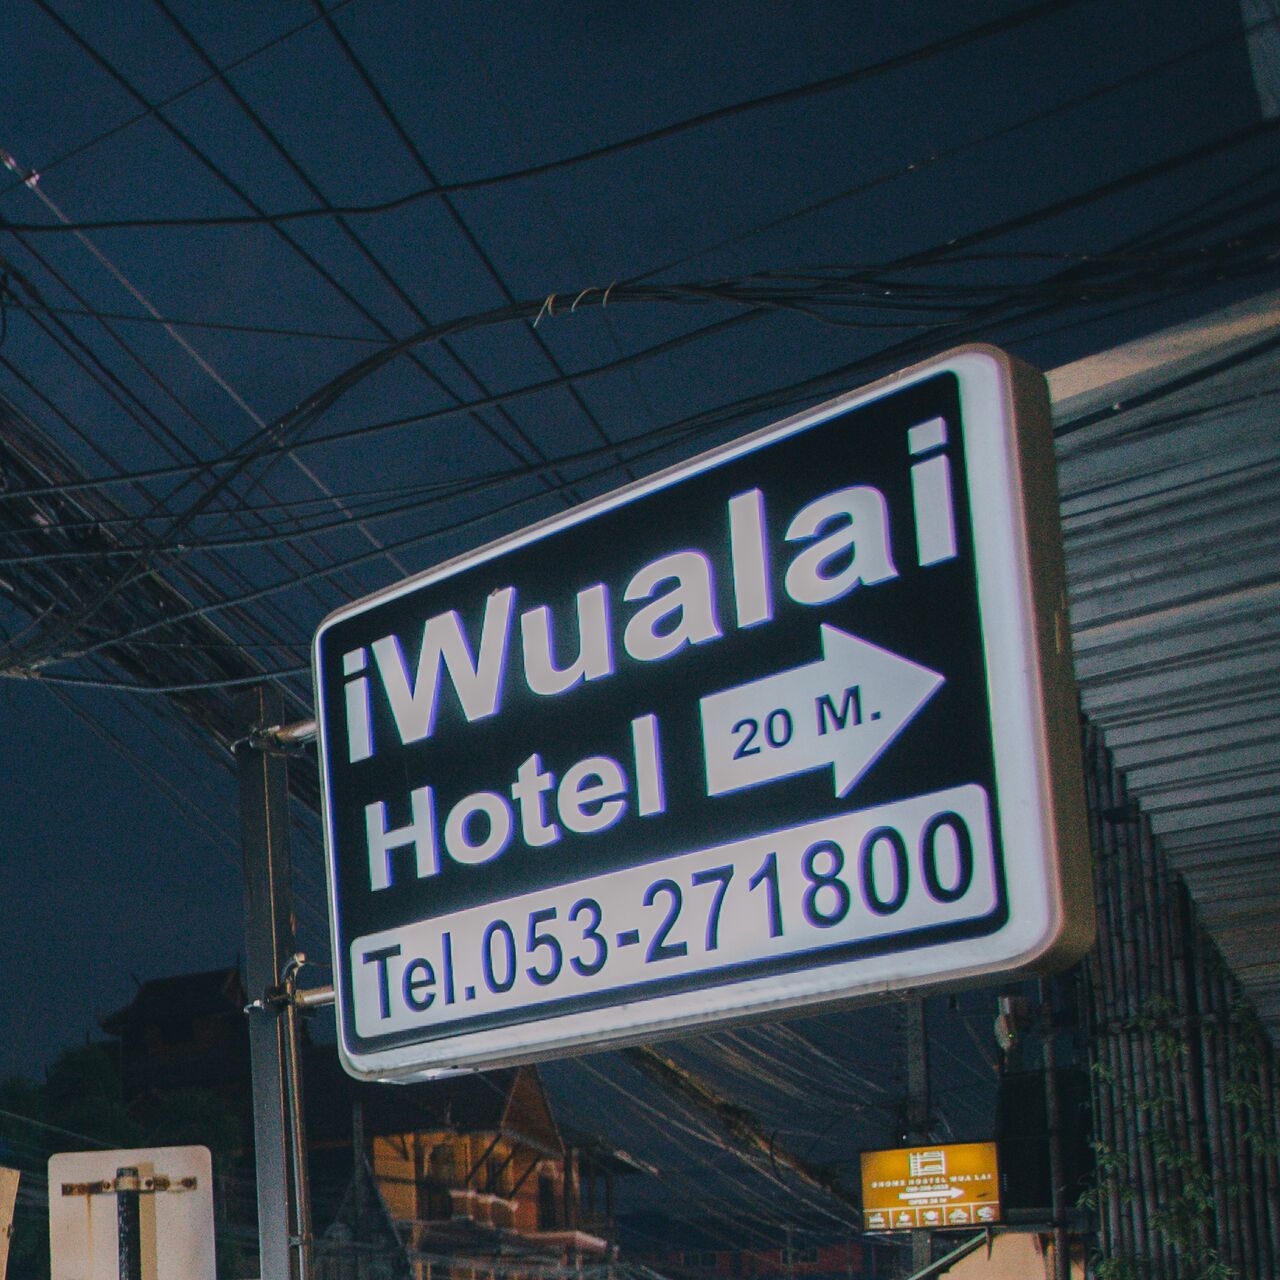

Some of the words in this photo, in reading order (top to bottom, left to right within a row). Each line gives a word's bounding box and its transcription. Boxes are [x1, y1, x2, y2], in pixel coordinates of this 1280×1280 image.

[343, 417, 959, 764] iWualai
[365, 712, 666, 892] Hotel
[730, 707, 795, 761] 20
[814, 684, 883, 736] M.
[362, 809, 974, 1022] Tel.053-271800
